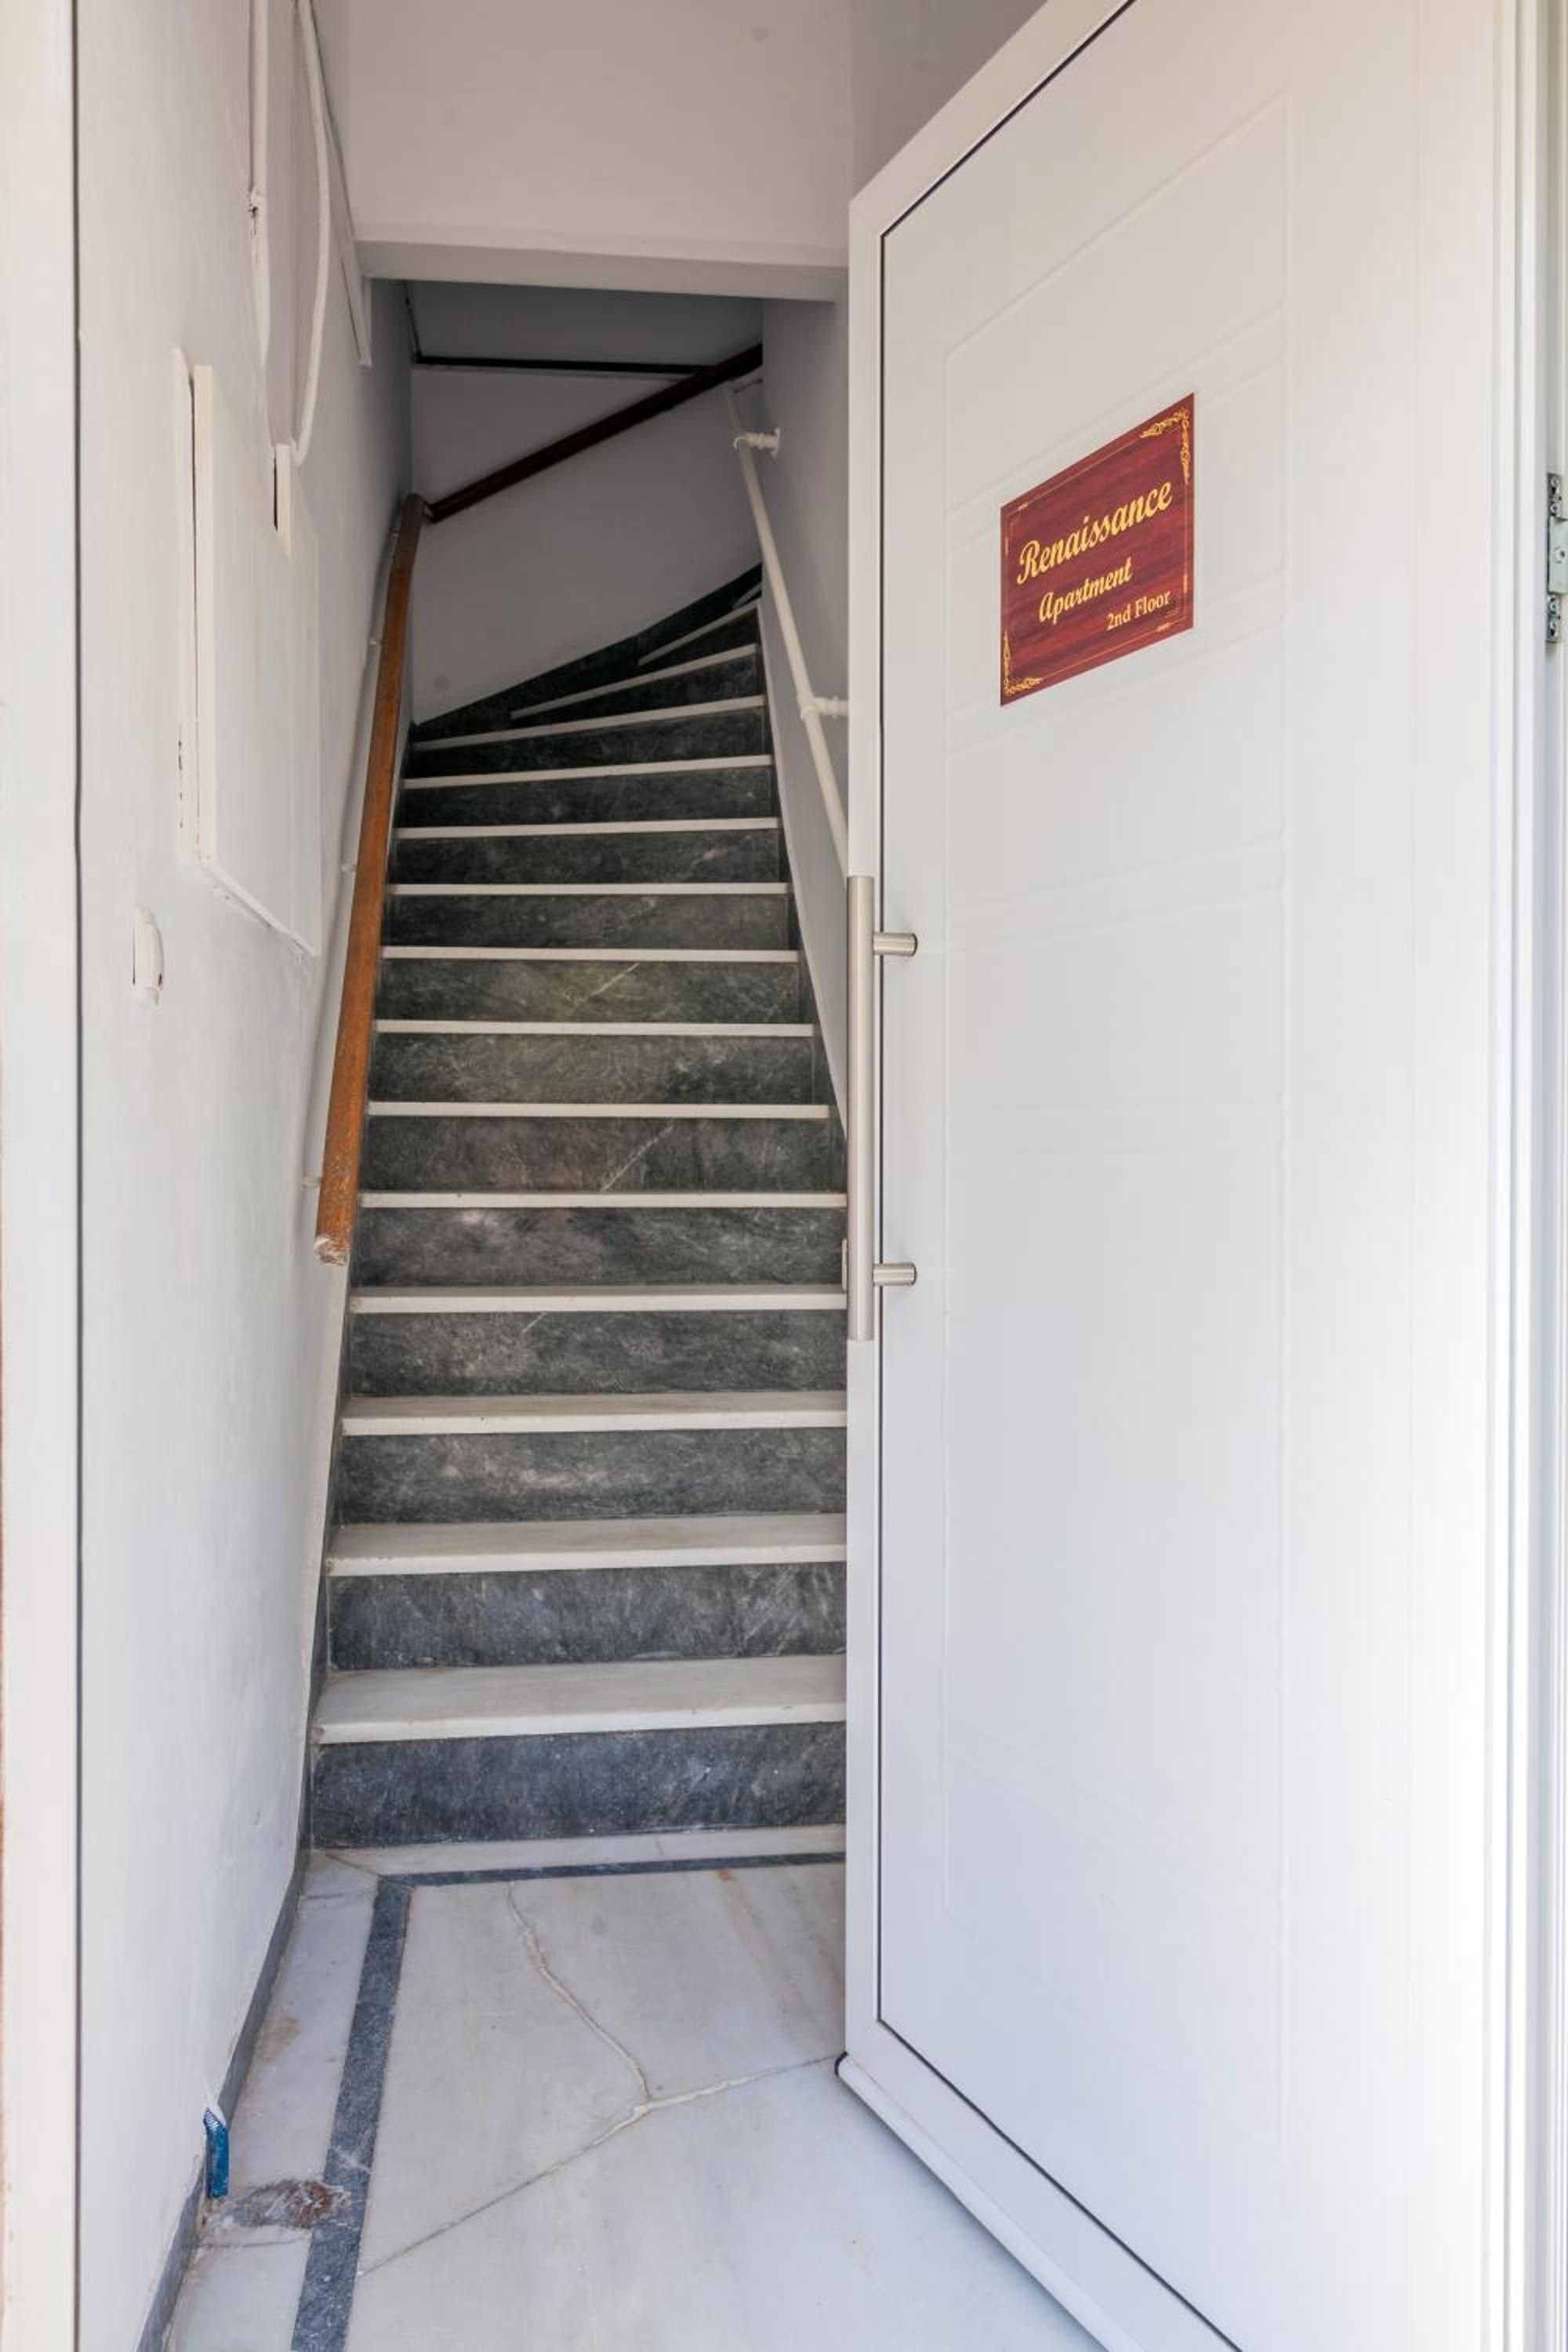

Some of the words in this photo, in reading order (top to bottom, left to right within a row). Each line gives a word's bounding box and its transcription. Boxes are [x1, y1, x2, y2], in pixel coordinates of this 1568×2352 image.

[1017, 481, 1173, 585] Renaissance
[1039, 557, 1134, 625] Apartment
[1106, 604, 1131, 631] 2nd
[1134, 590, 1171, 618] Floor
